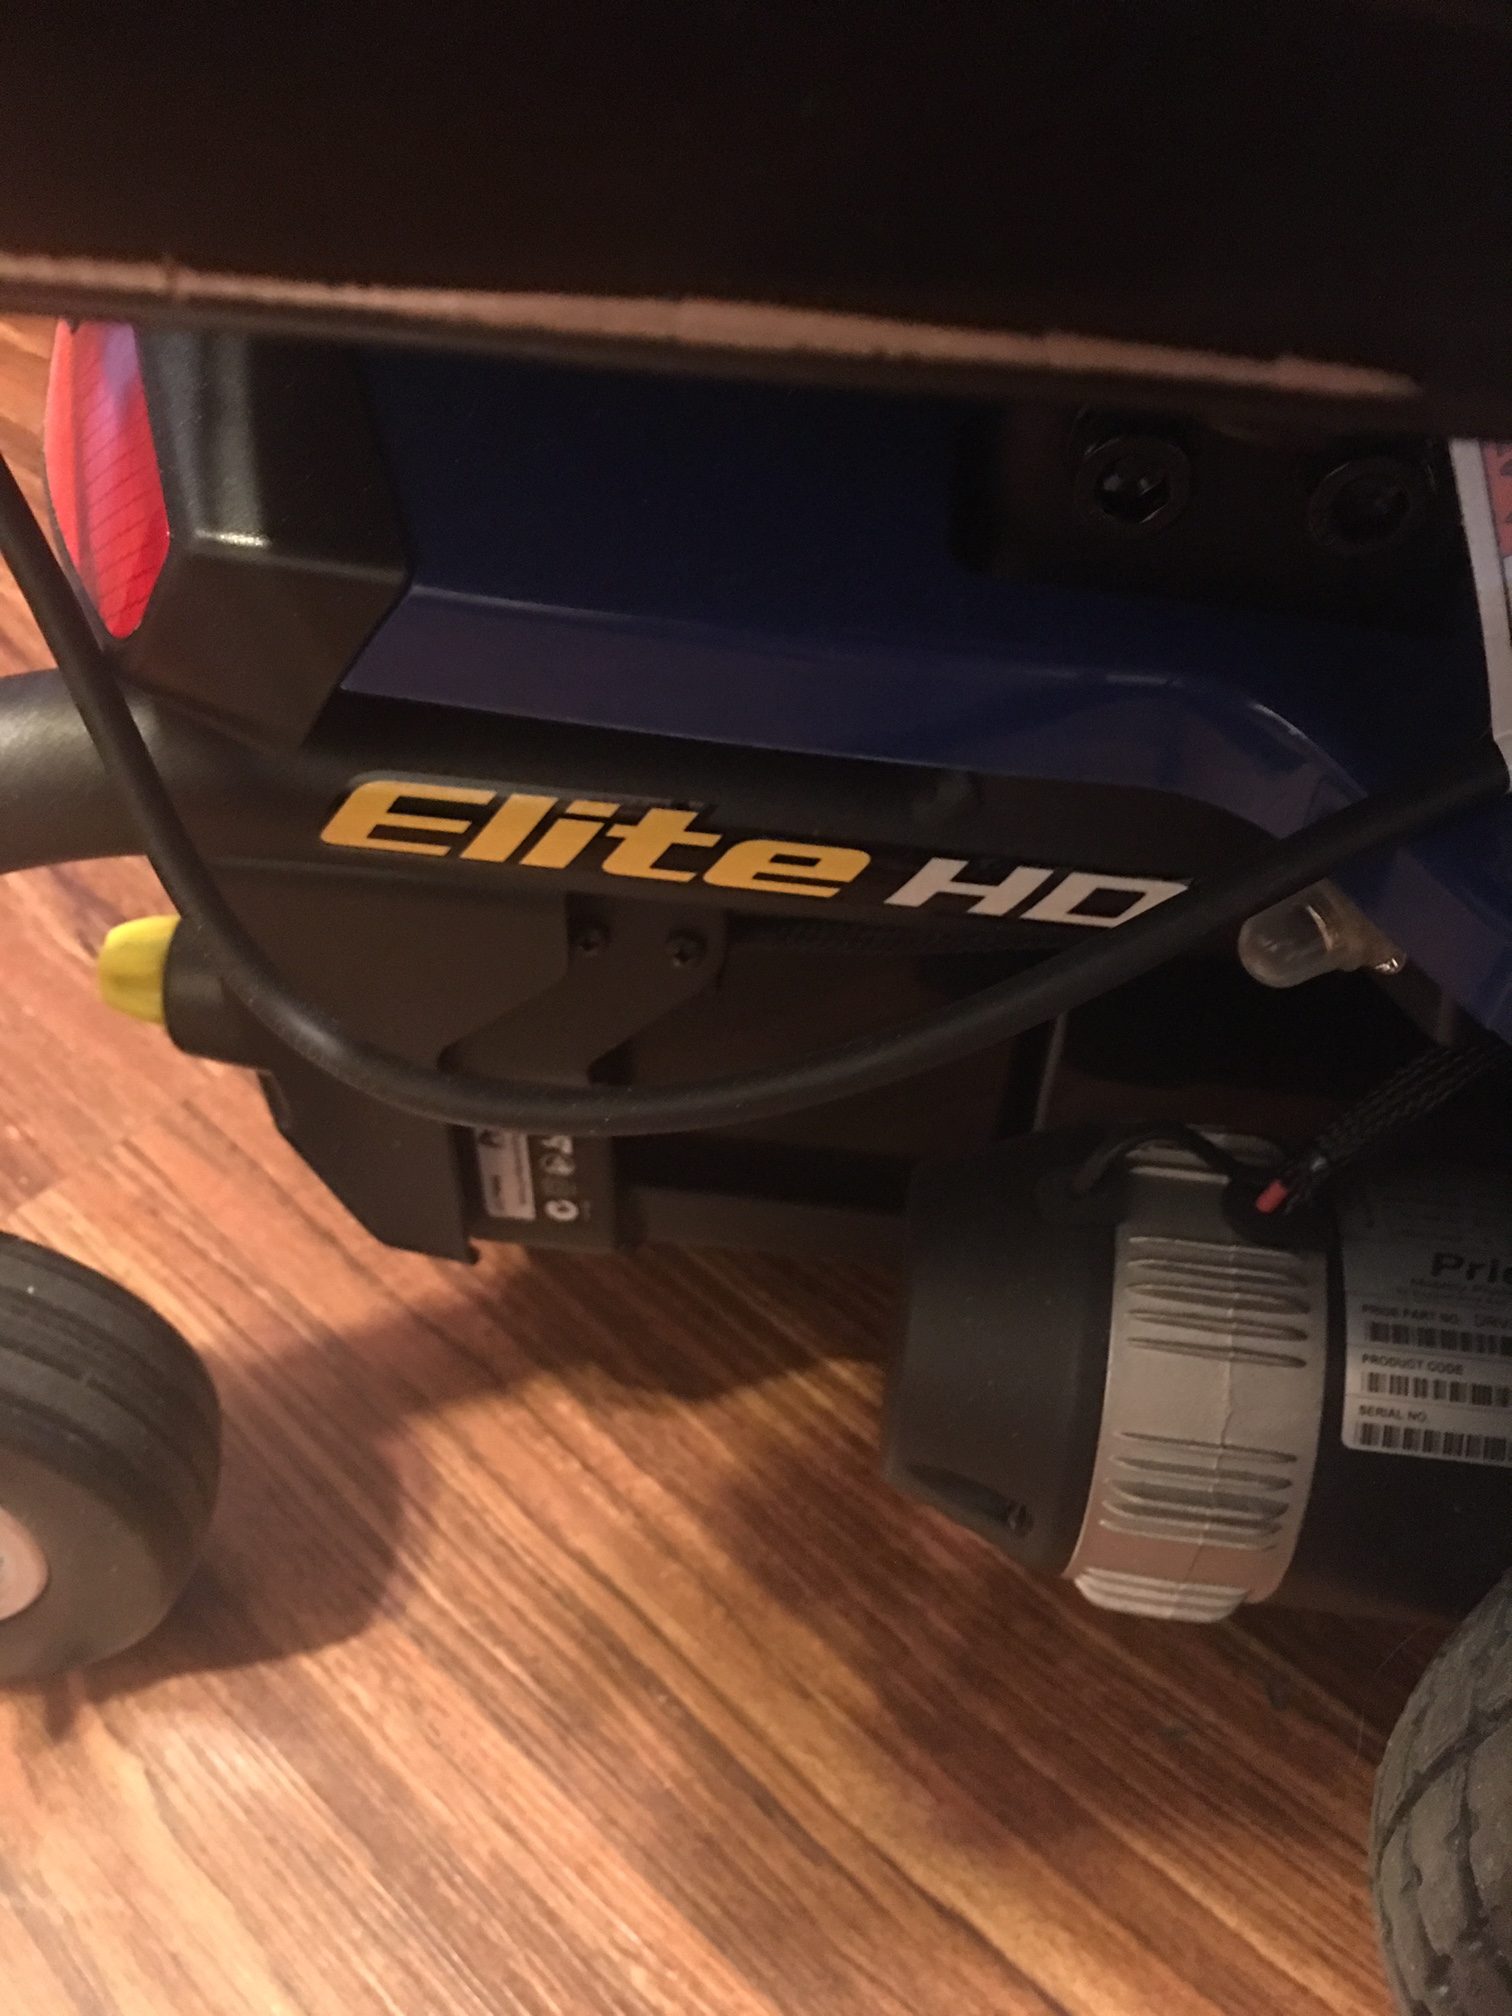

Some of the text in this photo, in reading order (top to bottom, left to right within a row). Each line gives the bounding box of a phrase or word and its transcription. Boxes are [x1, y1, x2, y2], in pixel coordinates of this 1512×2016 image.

[319, 779, 1190, 929] Elite HD
[1361, 1353, 1464, 1376] PRODUCT CODE
[1359, 1404, 1403, 1421] SERIAL
